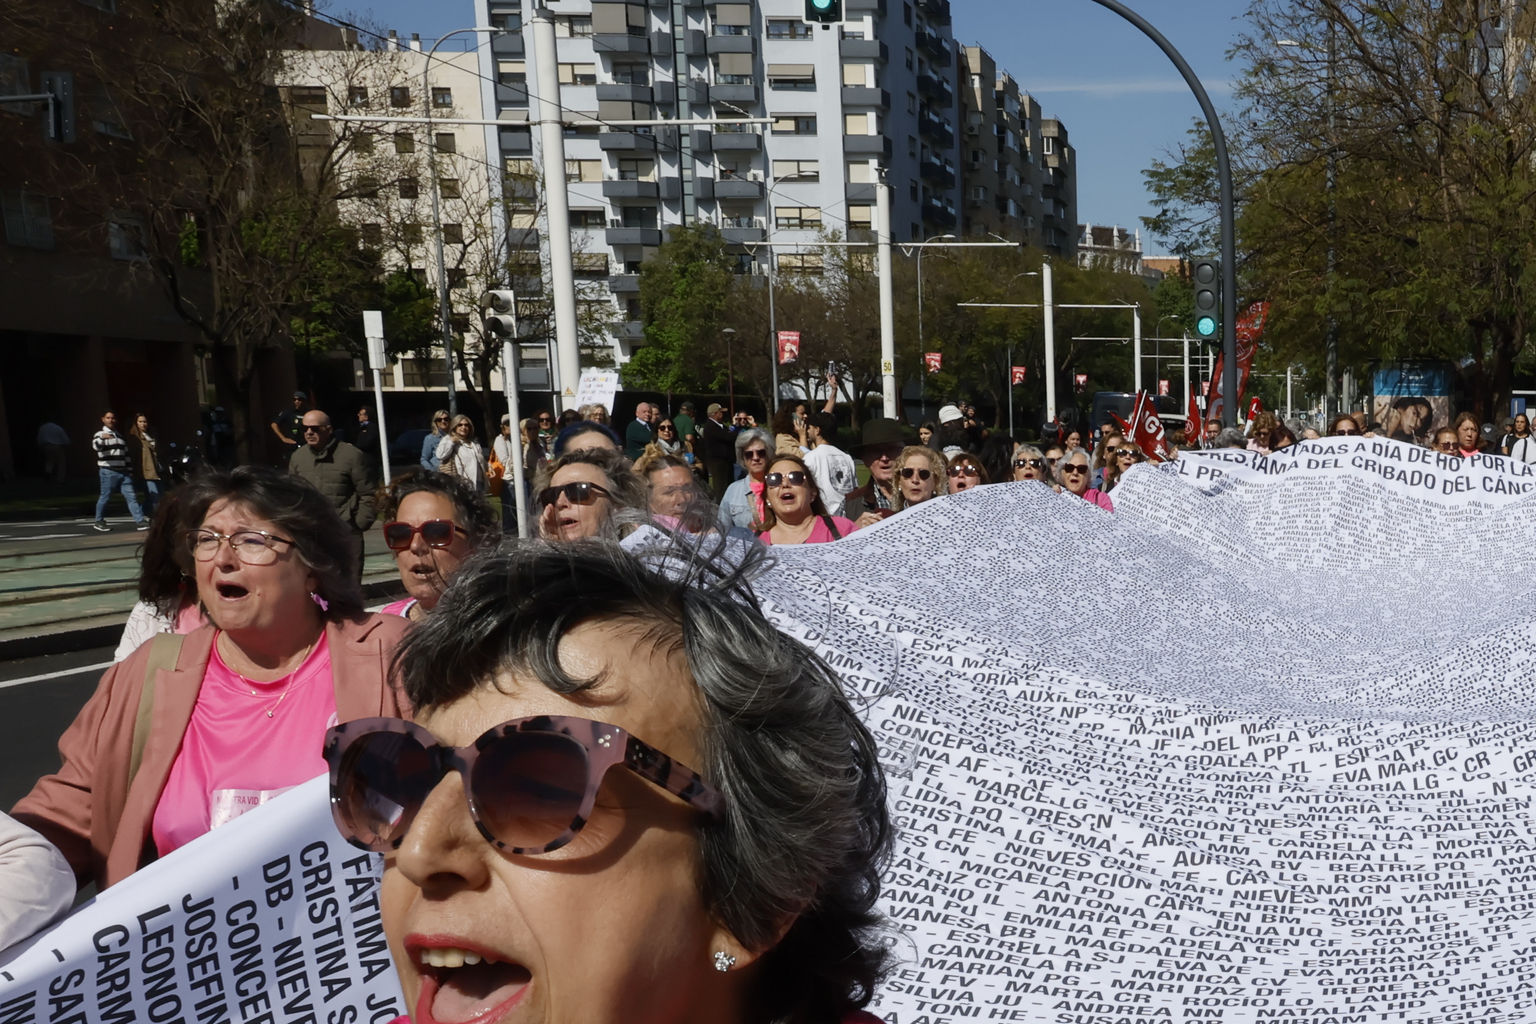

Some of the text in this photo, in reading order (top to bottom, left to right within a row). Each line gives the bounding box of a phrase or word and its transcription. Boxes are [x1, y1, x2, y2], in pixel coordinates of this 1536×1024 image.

[884, 362, 891, 371] 50
[1307, 458, 1344, 469] DEL
[1351, 456, 1436, 490] CRIBADO
[1442, 476, 1476, 495] DEL
[1354, 443, 1366, 452] A
[1372, 441, 1402, 461] DÍA
[1408, 448, 1431, 464] DE
[1471, 455, 1506, 473] POR
[1510, 461, 1534, 477] LA
[1372, 482, 1386, 492] ANA
[1406, 494, 1420, 504] ANA
[1422, 500, 1447, 510] MARIA
[893, 801, 1006, 837] CRISTINA
[1004, 841, 1092, 868] NIEVES
[262, 854, 294, 908] DB
[300, 839, 357, 1004] CRISTINA
[920, 957, 1247, 997] MARIAN PG MARI PAZ
[927, 943, 1238, 986] CANDELA RP MÓNICA
[885, 981, 1172, 1018] SILVIA JU ANDREA
[915, 999, 982, 1018] TOÑI
[988, 1008, 1028, 1021] HE
[1256, 1004, 1377, 1018] NATALIA
